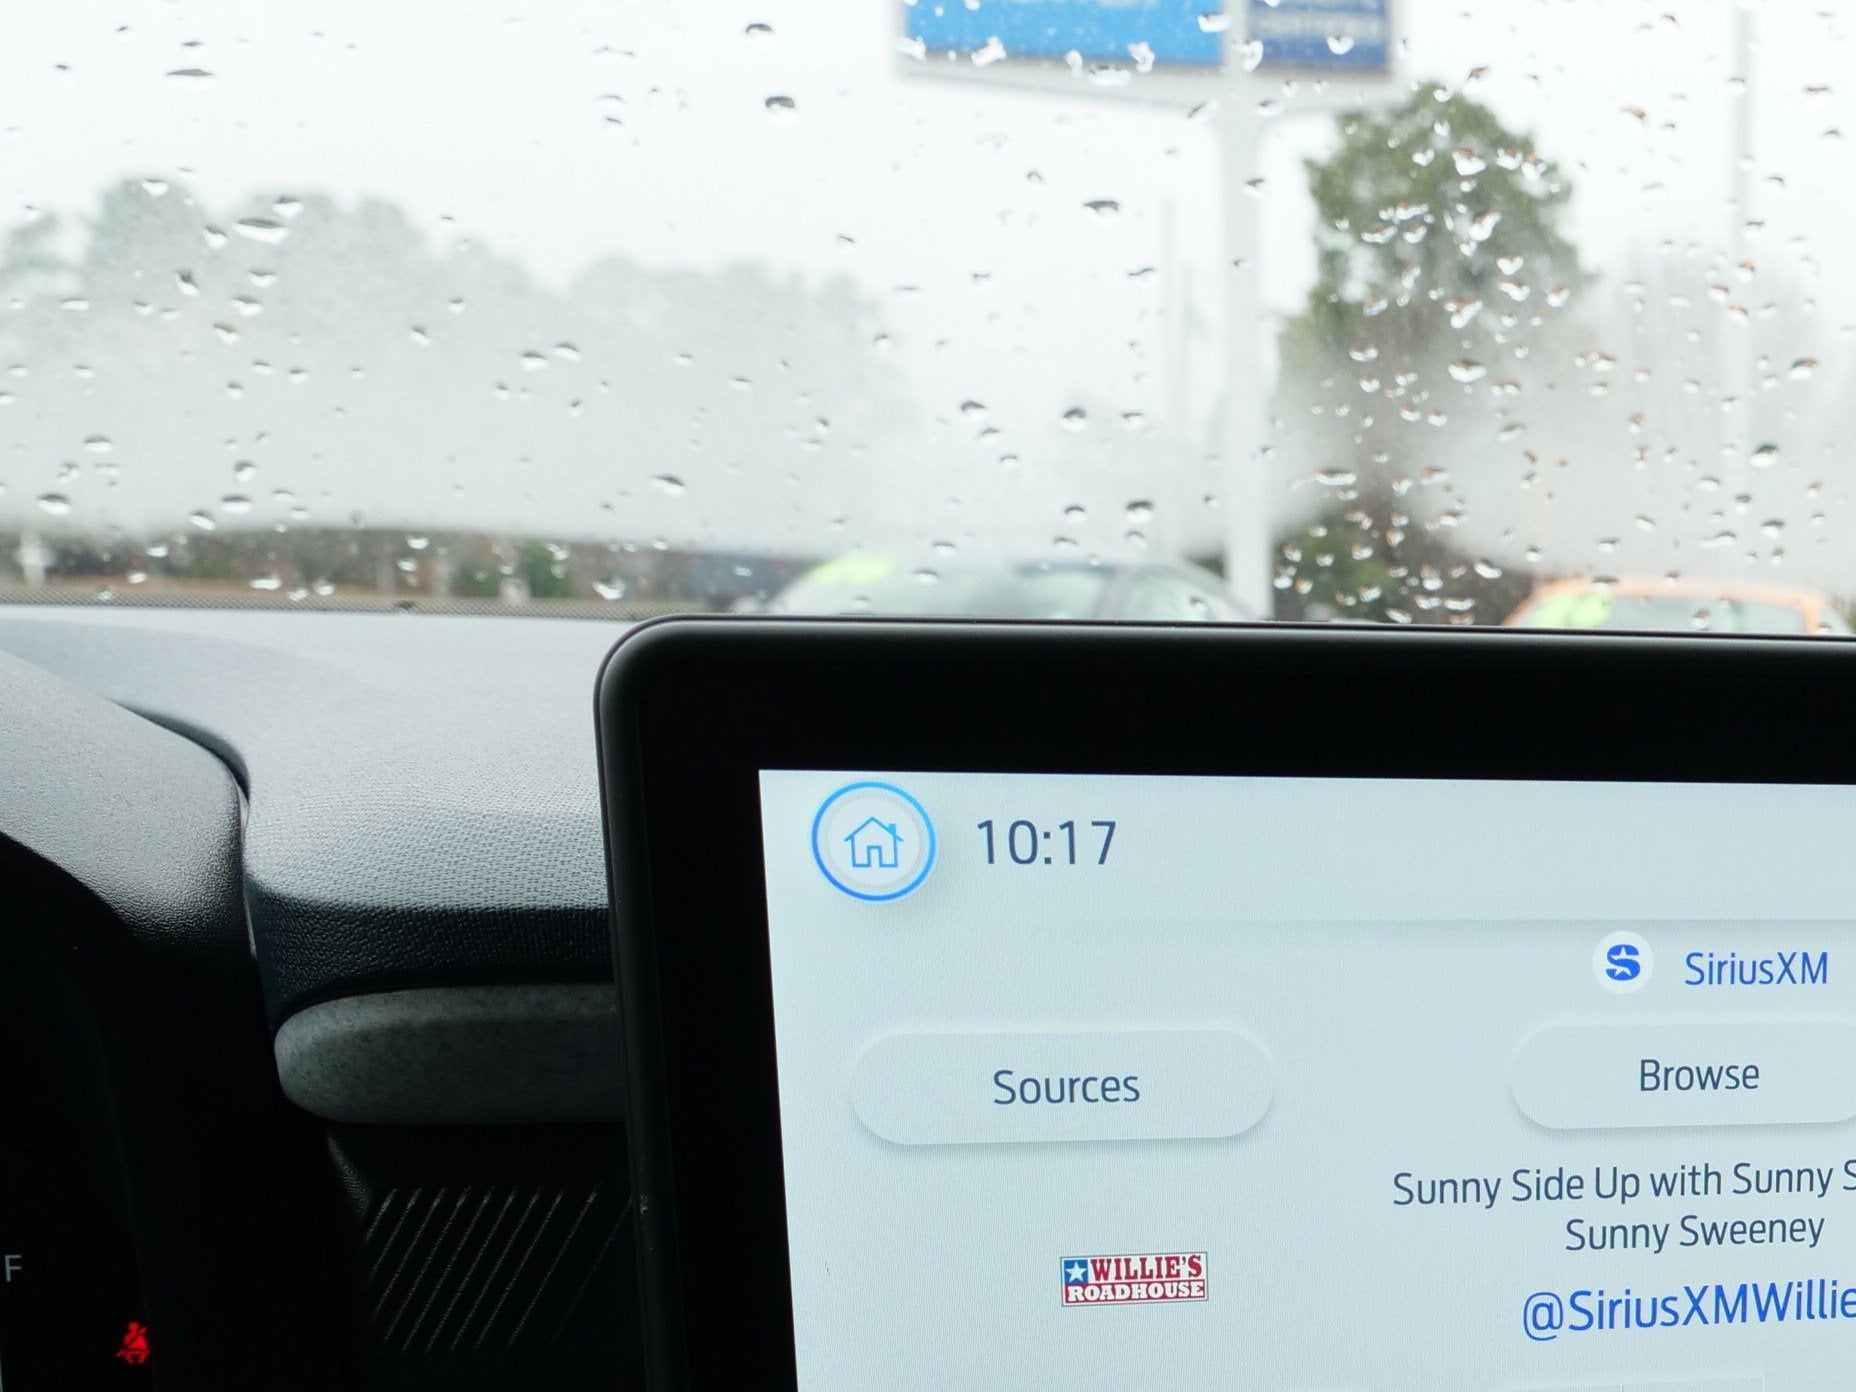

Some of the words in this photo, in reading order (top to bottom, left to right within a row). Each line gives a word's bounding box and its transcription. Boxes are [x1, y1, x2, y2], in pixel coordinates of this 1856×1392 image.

[976, 819, 1118, 866] 10:17
[1685, 951, 1829, 986] SiriusXM
[992, 1069, 1141, 1106] Sources
[1639, 1058, 1760, 1092] Browse
[1393, 1172, 1501, 1209] Sunny
[1511, 1167, 1585, 1202] Side
[1594, 1166, 1641, 1204] Up
[1650, 1161, 1722, 1197] with
[1732, 1160, 1833, 1198] Sunny
[1565, 1218, 1670, 1254] Sunny
[1679, 1213, 1825, 1248] Sweeney
[4, 1254, 22, 1282] F
[1090, 1254, 1203, 1282] WILLIE'S
[1067, 1281, 1205, 1302] ROADHOUSE
